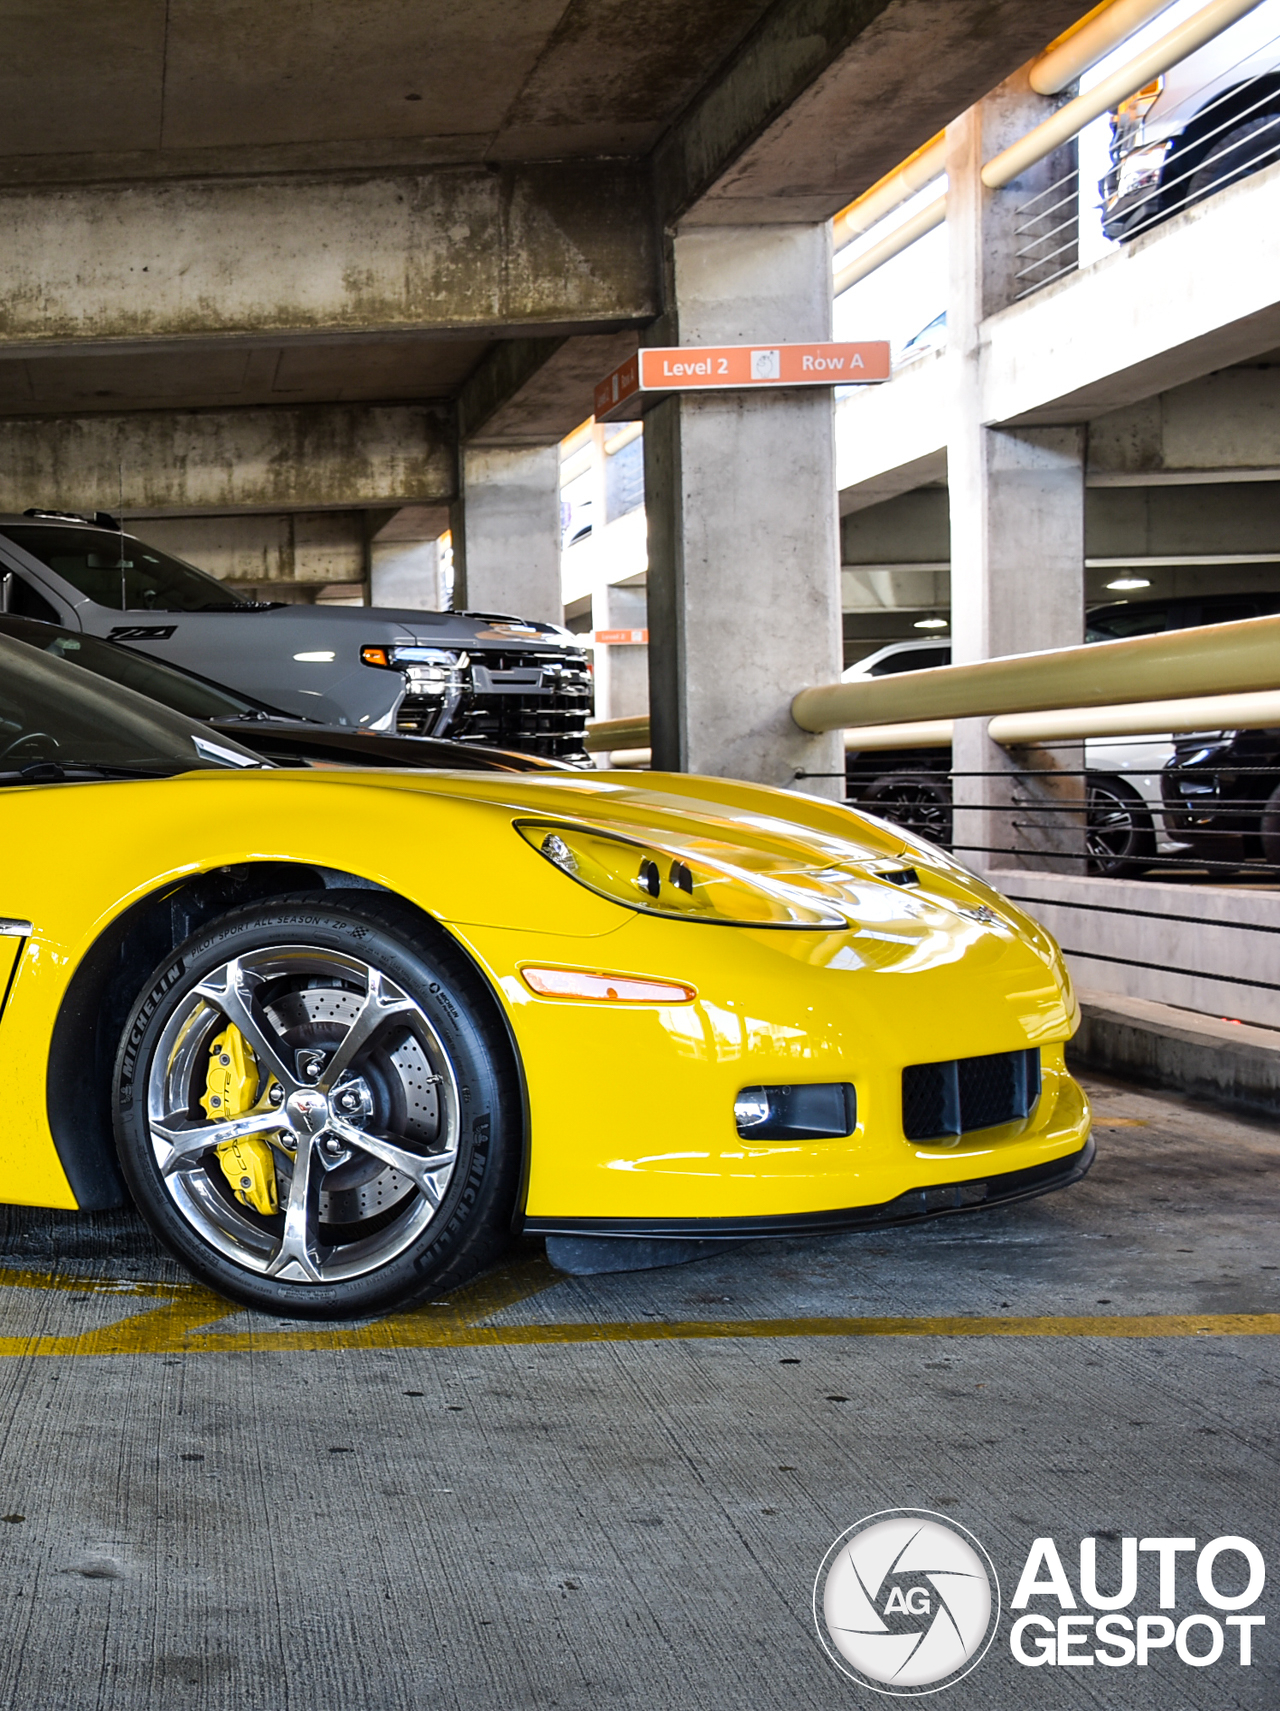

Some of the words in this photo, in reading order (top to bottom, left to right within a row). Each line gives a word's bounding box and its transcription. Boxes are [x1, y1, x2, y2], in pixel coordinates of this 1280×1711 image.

[663, 358, 711, 376] Level
[717, 358, 728, 375] 2
[802, 355, 844, 371] Row
[850, 354, 864, 369] A
[191, 937, 215, 958] PILOT
[218, 922, 250, 940] SPORT
[254, 917, 273, 928] ALL
[276, 915, 321, 925] SEASON
[332, 921, 347, 930] ZP
[122, 966, 182, 1079] MICHELIN
[440, 992, 459, 1018] MICHELIN
[420, 1152, 486, 1268] MICHELIN
